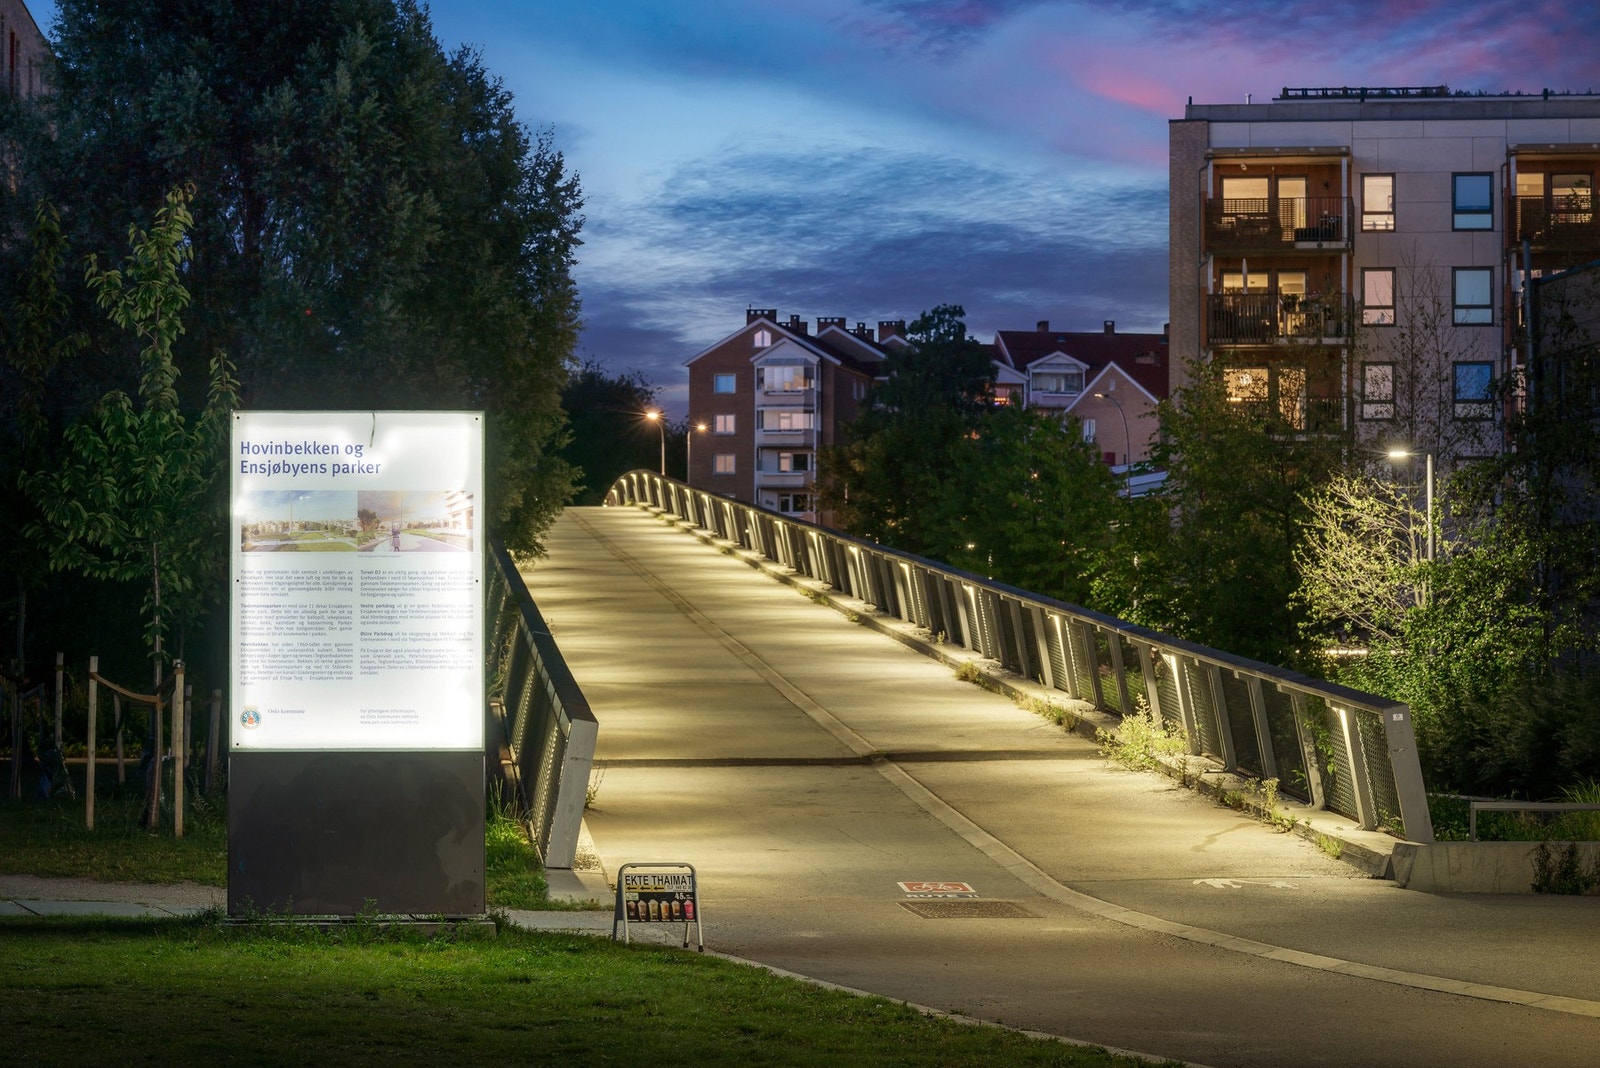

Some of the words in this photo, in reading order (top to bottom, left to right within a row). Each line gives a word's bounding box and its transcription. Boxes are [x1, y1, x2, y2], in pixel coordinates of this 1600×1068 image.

[241, 441, 339, 455] Hovinbekken
[345, 444, 364, 458] og
[241, 460, 327, 477] Ensjøbyens
[332, 460, 381, 477] parker
[625, 876, 648, 886] EKTE
[652, 876, 692, 886] THAIMAT
